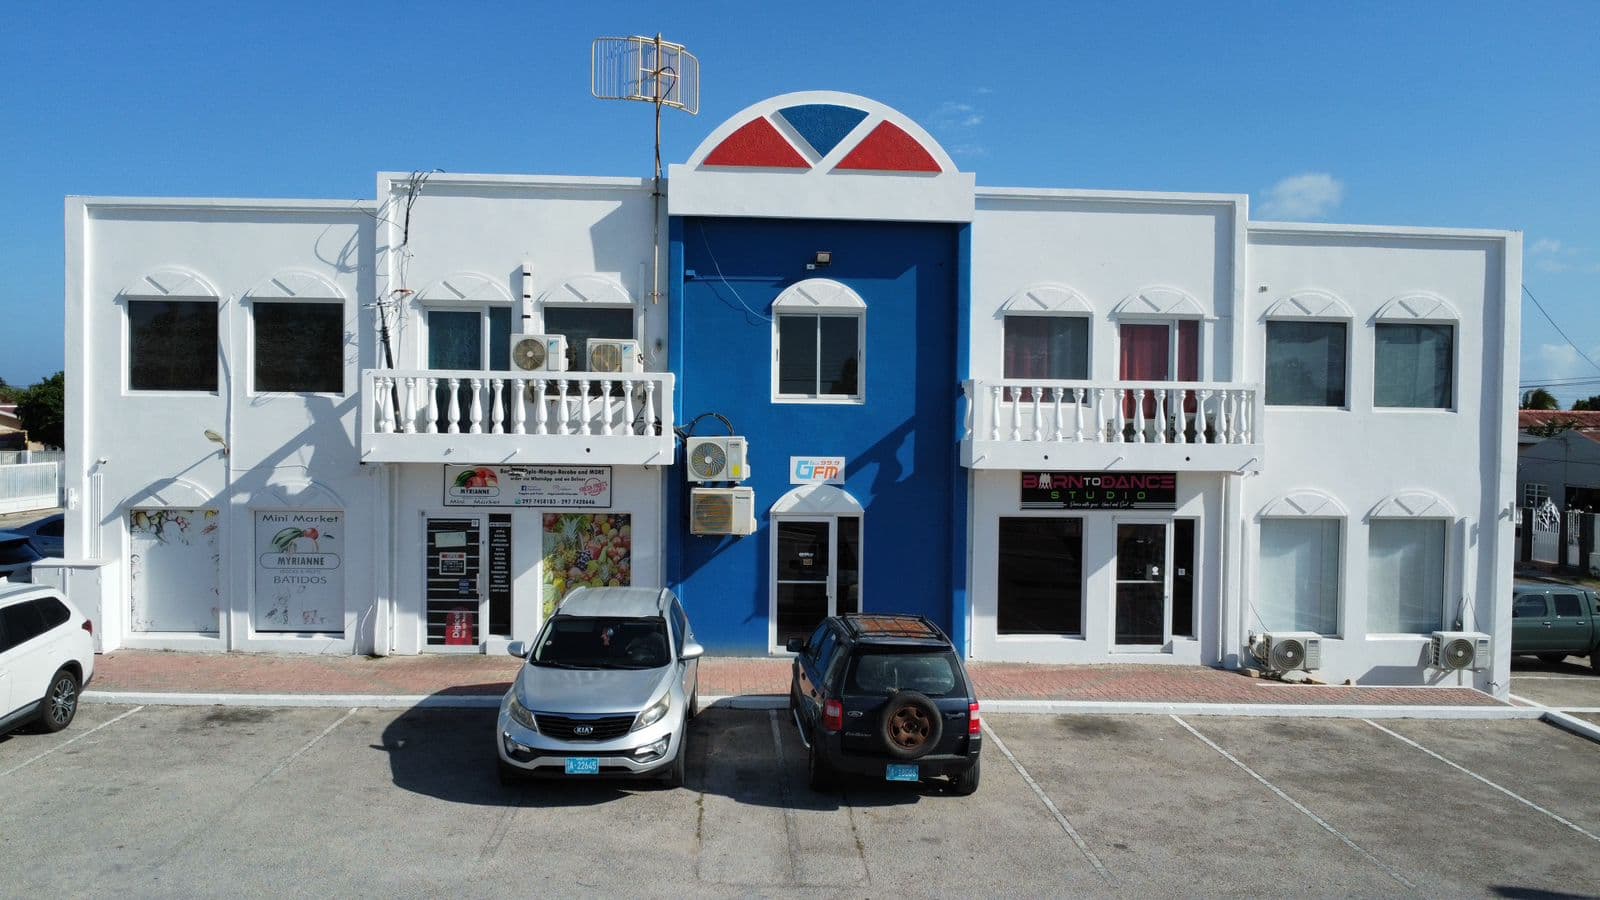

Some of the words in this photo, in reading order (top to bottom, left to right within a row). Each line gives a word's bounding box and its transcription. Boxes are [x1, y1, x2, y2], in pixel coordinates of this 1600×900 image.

[1022, 474, 1083, 489] BRN
[1083, 477, 1101, 487] TO
[1101, 474, 1175, 489] DANCE
[1050, 491, 1146, 500] STUDIO
[262, 514, 289, 522] Mini
[293, 514, 338, 522] Market
[277, 557, 325, 566] MYRIANNE
[273, 575, 328, 584] BATIDOS
